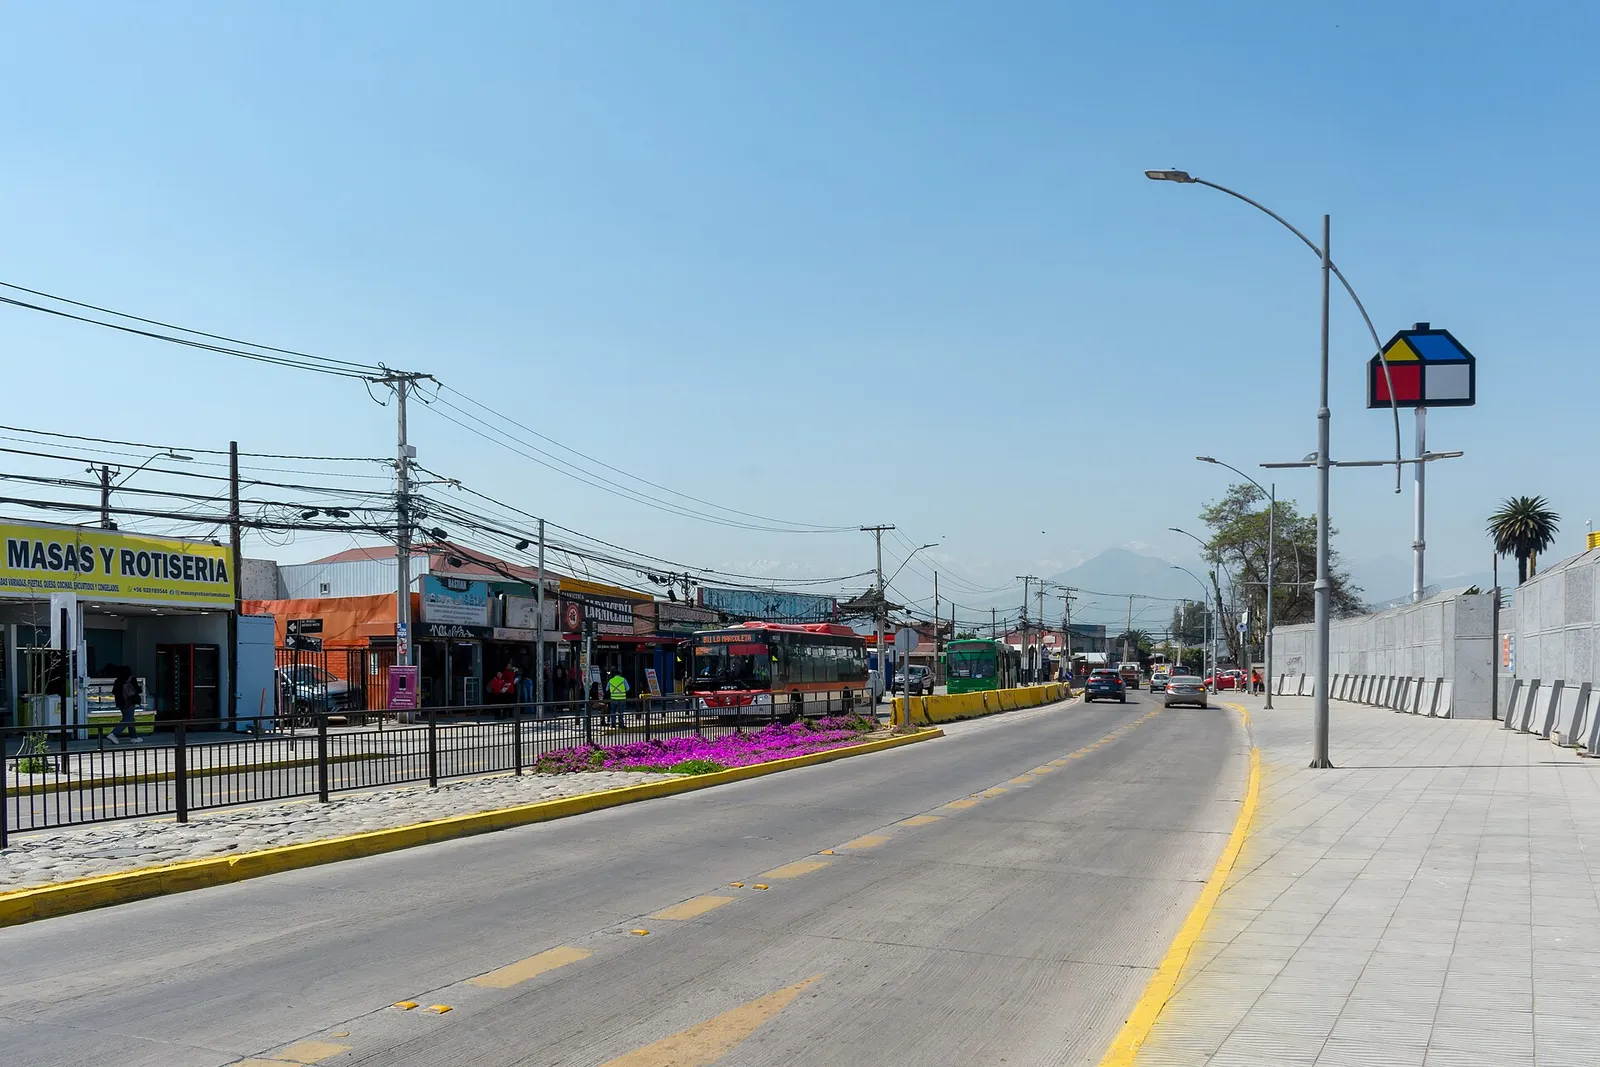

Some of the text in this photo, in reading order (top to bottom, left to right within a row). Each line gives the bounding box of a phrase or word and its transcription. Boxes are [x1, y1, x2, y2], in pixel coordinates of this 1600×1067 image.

[7, 539, 228, 582] MASAS Y ROTISERIA
[722, 634, 751, 642] MARCOLETA
